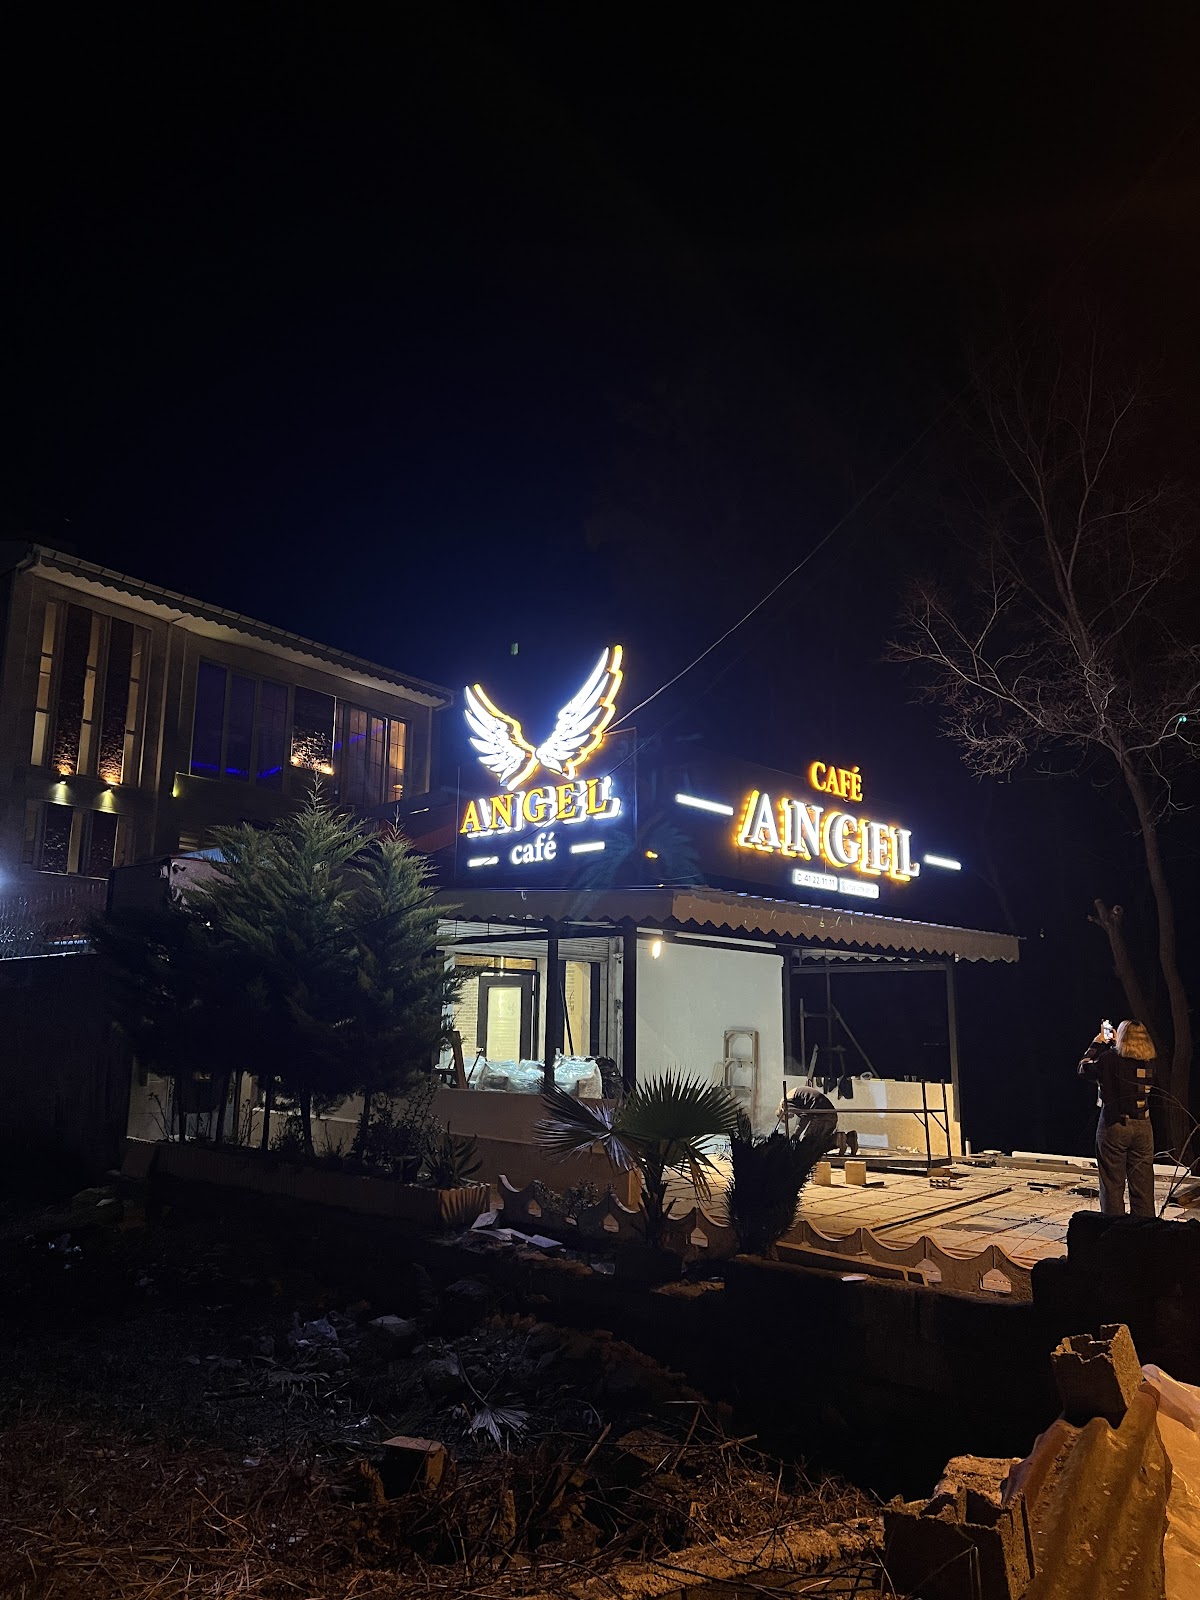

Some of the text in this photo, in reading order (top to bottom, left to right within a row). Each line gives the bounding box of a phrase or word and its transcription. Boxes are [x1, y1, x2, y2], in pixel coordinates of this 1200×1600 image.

[809, 760, 863, 802] CAFÉ
[460, 777, 616, 837] ANGEL
[510, 831, 557, 865] café
[737, 790, 920, 881] ANGEL
